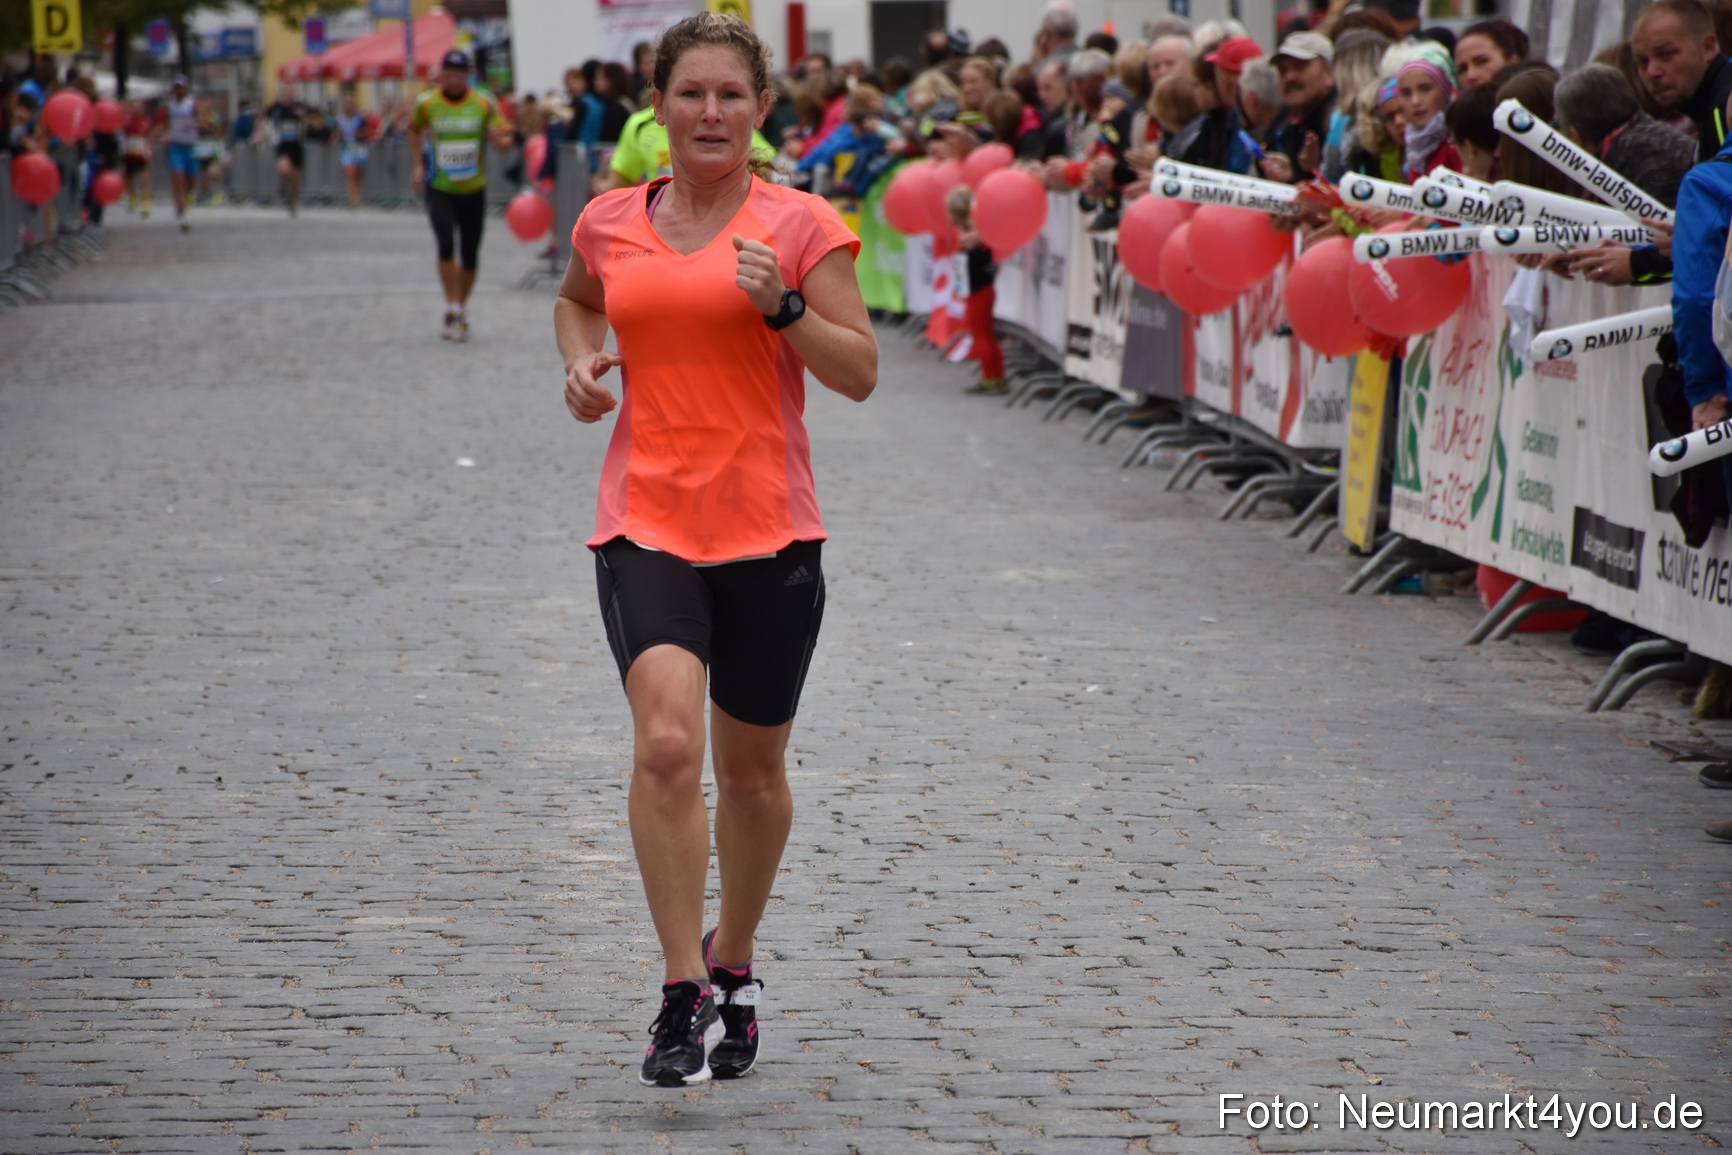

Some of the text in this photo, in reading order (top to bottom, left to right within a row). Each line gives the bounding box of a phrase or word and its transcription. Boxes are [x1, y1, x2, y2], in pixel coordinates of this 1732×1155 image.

[46, 5, 69, 38] D
[1541, 132, 1668, 221] bmw-laufsport
[1191, 184, 1234, 203] BMW
[1459, 197, 1515, 225] BMW
[1401, 234, 1448, 255] BMW
[1535, 226, 1590, 243] BMW
[1583, 326, 1634, 353] BMW
[783, 573, 815, 587] adidas
